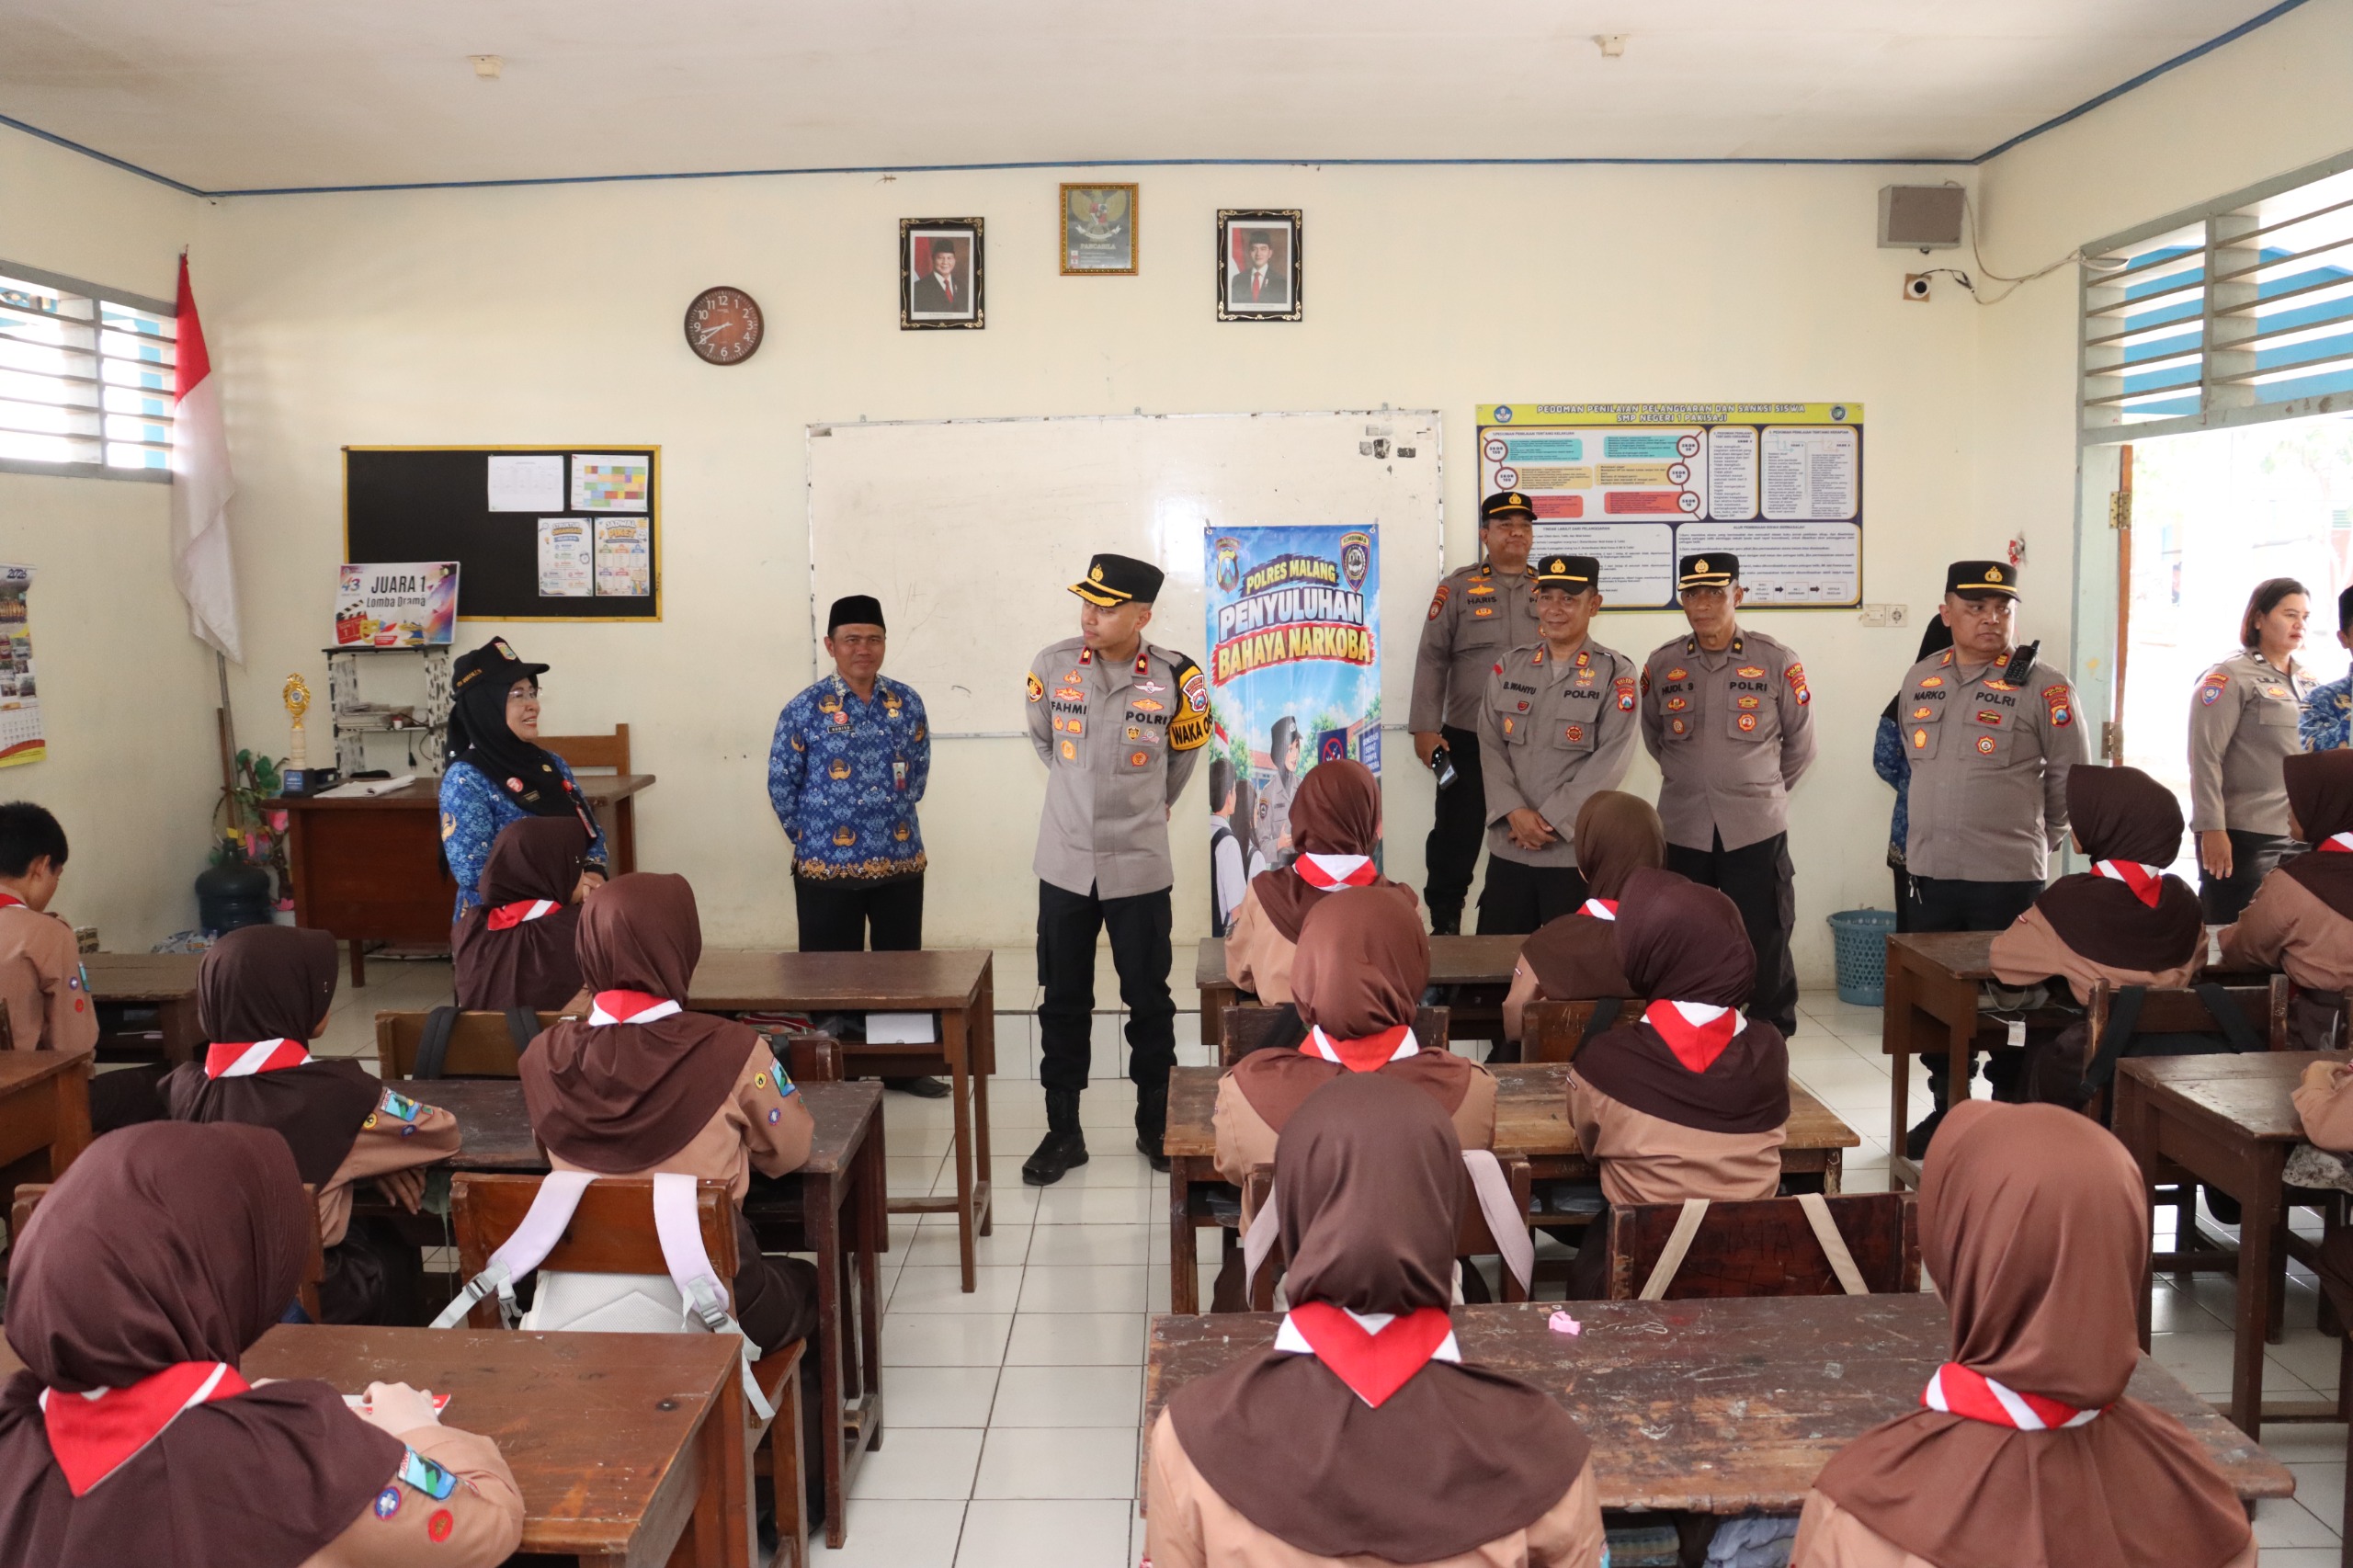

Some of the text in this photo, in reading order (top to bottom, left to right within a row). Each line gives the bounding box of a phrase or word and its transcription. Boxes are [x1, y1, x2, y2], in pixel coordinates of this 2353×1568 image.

[707, 300, 715, 310] 11
[718, 295, 728, 305] 12
[734, 299, 738, 309] 1
[699, 310, 709, 320] 10
[743, 308, 749, 318] 2
[693, 322, 701, 332] 9
[746, 320, 754, 330] 3
[743, 332, 750, 341] 4
[708, 343, 715, 353] 7
[721, 347, 728, 357] 6
[734, 342, 741, 352] 5
[1537, 404, 1805, 414] PEDOMAN PENILAIAN PELANGGARAN DAN SANKSI SISWA
[1617, 414, 1727, 423] SMP NEGERI 1 PAKISAJI
[606, 520, 636, 529] JADWAL
[608, 528, 636, 539] PIKET
[1246, 560, 1336, 595] POLRES MALANG
[341, 576, 360, 592] 43
[370, 575, 426, 594] JUARA 1
[366, 597, 426, 608] Lomba Drama
[1467, 597, 1497, 605] HARIS
[1219, 588, 1364, 642] PENYULUHAN
[1218, 626, 1370, 681] BAHAYA NARKOBA
[1729, 681, 1768, 692] POLRI
[1563, 690, 1600, 699] POLRI
[1914, 690, 1947, 701] NARKO
[1976, 692, 2016, 708] POLRI
[1051, 701, 1086, 715] FAHMI
[1126, 710, 1167, 725] POLRI
[1171, 722, 1203, 745] WAKA
